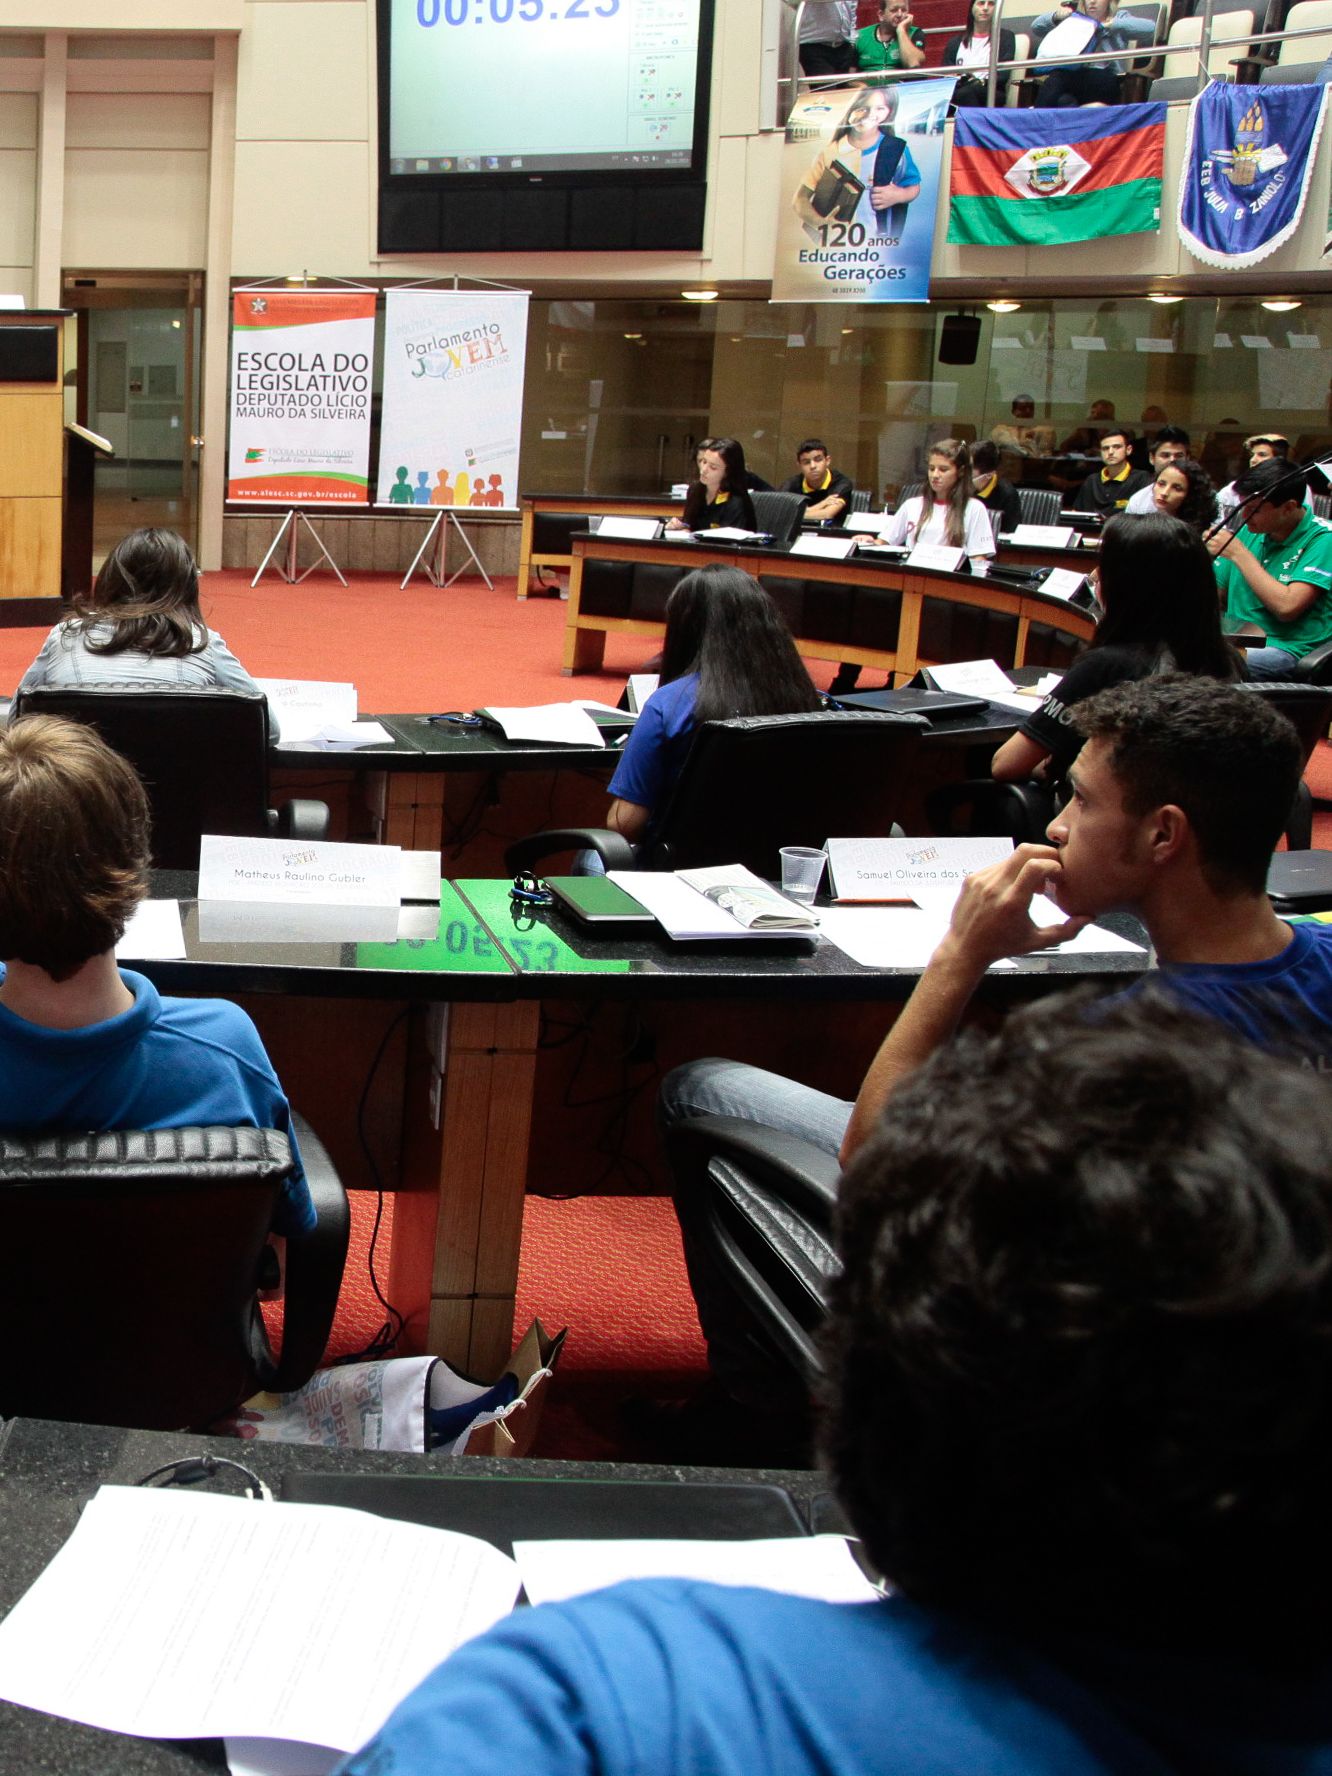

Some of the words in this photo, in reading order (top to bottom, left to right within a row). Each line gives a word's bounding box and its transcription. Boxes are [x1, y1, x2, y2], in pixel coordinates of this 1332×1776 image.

[1200, 160, 1215, 187] EEB
[1234, 207, 1245, 220] B
[818, 223, 866, 247] 120
[868, 236, 899, 247] anos
[799, 248, 880, 263] Educando
[823, 265, 907, 284] Gerações
[405, 323, 500, 358] Parlamento
[237, 352, 325, 372] ESCOLA
[333, 353, 369, 372] DO
[411, 334, 508, 378] JOVEM
[446, 354, 510, 380] catarinense
[237, 373, 368, 392] LEGISLATIVO
[236, 392, 322, 407] DEPUTADO
[327, 391, 367, 407] LÍCIO
[236, 406, 285, 418] MAURO
[288, 407, 307, 418] DA
[310, 408, 366, 420] SILVEIRA
[234, 869, 281, 880] Matheus
[284, 870, 325, 882] Raulino
[328, 872, 366, 883] Gubler
[856, 870, 892, 880] Samuel
[895, 869, 937, 879] Oliveira
[940, 869, 959, 878] dos
